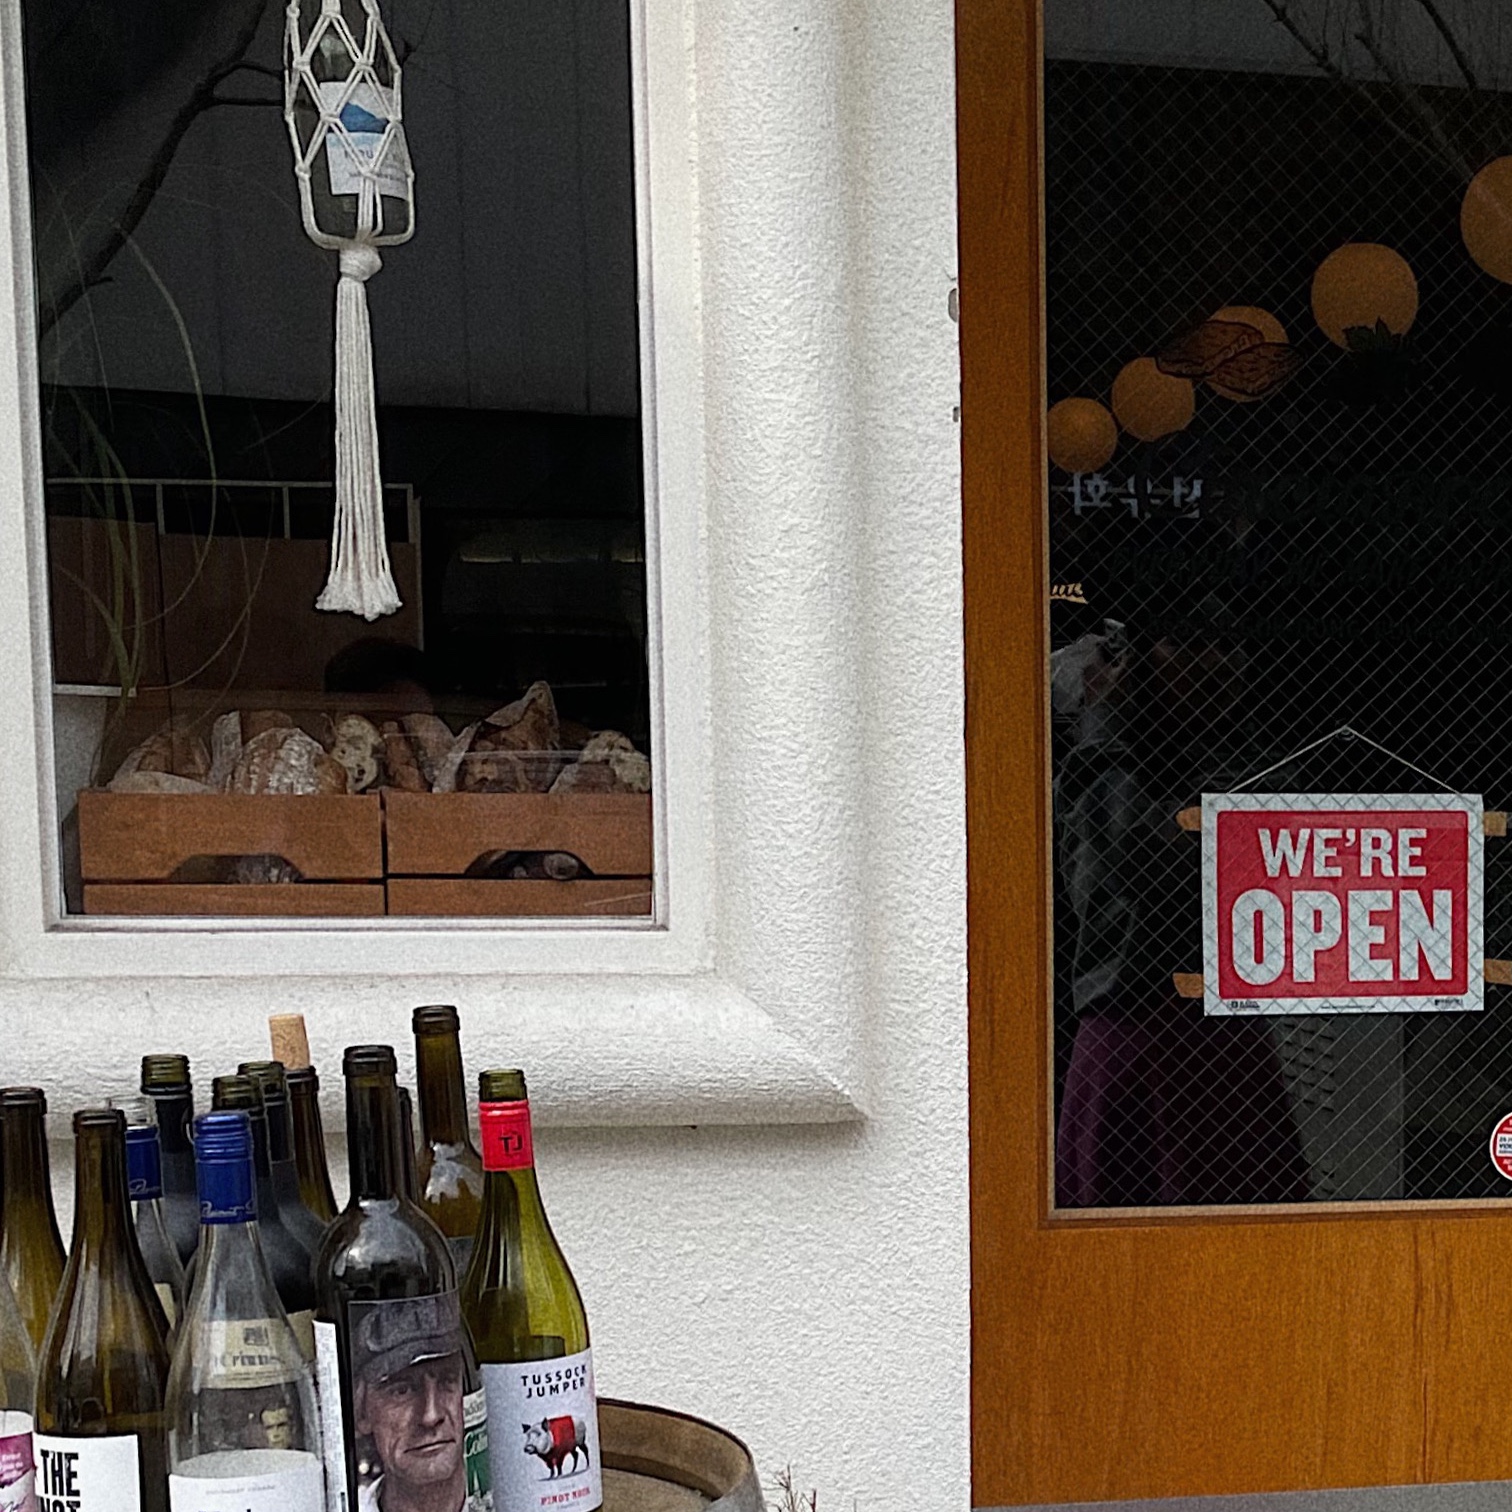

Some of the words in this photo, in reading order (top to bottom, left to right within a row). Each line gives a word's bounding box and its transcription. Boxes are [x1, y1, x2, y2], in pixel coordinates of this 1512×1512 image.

[1258, 827, 1428, 878] WE'RE
[1231, 888, 1453, 987] OPEN
[521, 1363, 588, 1388] TUSSOCK
[526, 1376, 587, 1400] JUMPER
[40, 1448, 81, 1497] THE
